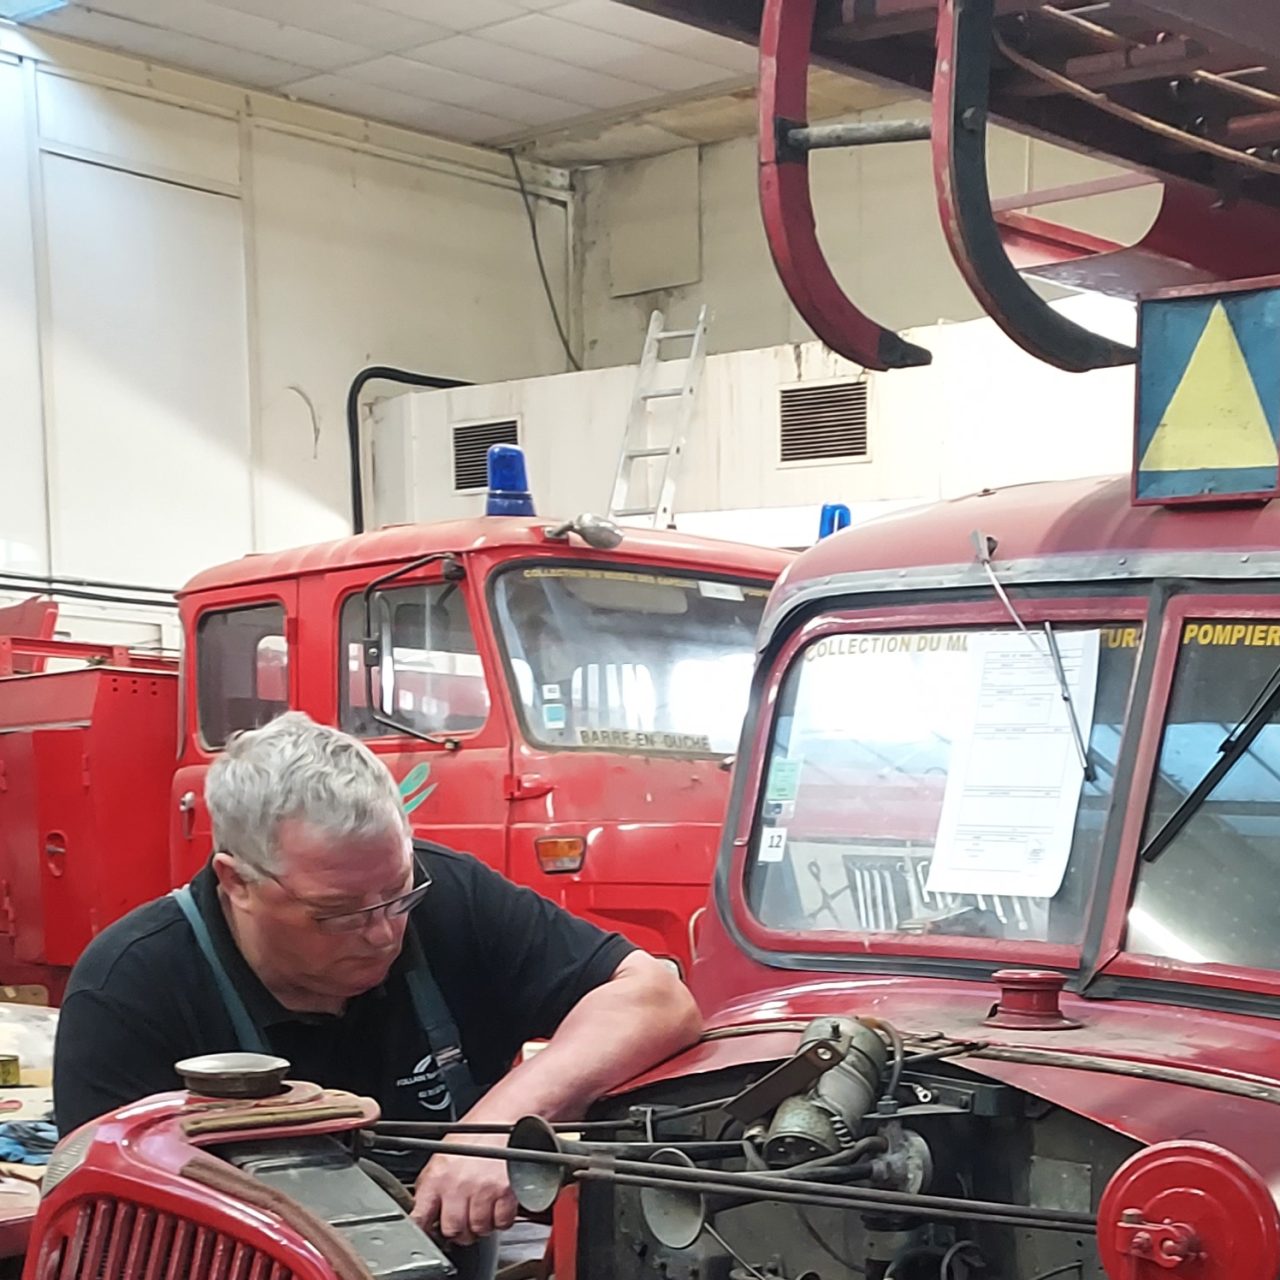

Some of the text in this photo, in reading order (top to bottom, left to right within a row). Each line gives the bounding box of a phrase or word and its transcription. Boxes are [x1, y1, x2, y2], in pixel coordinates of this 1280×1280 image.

[805, 636, 911, 662] COLLECTION
[917, 636, 941, 652] DU
[767, 834, 783, 848] 12
